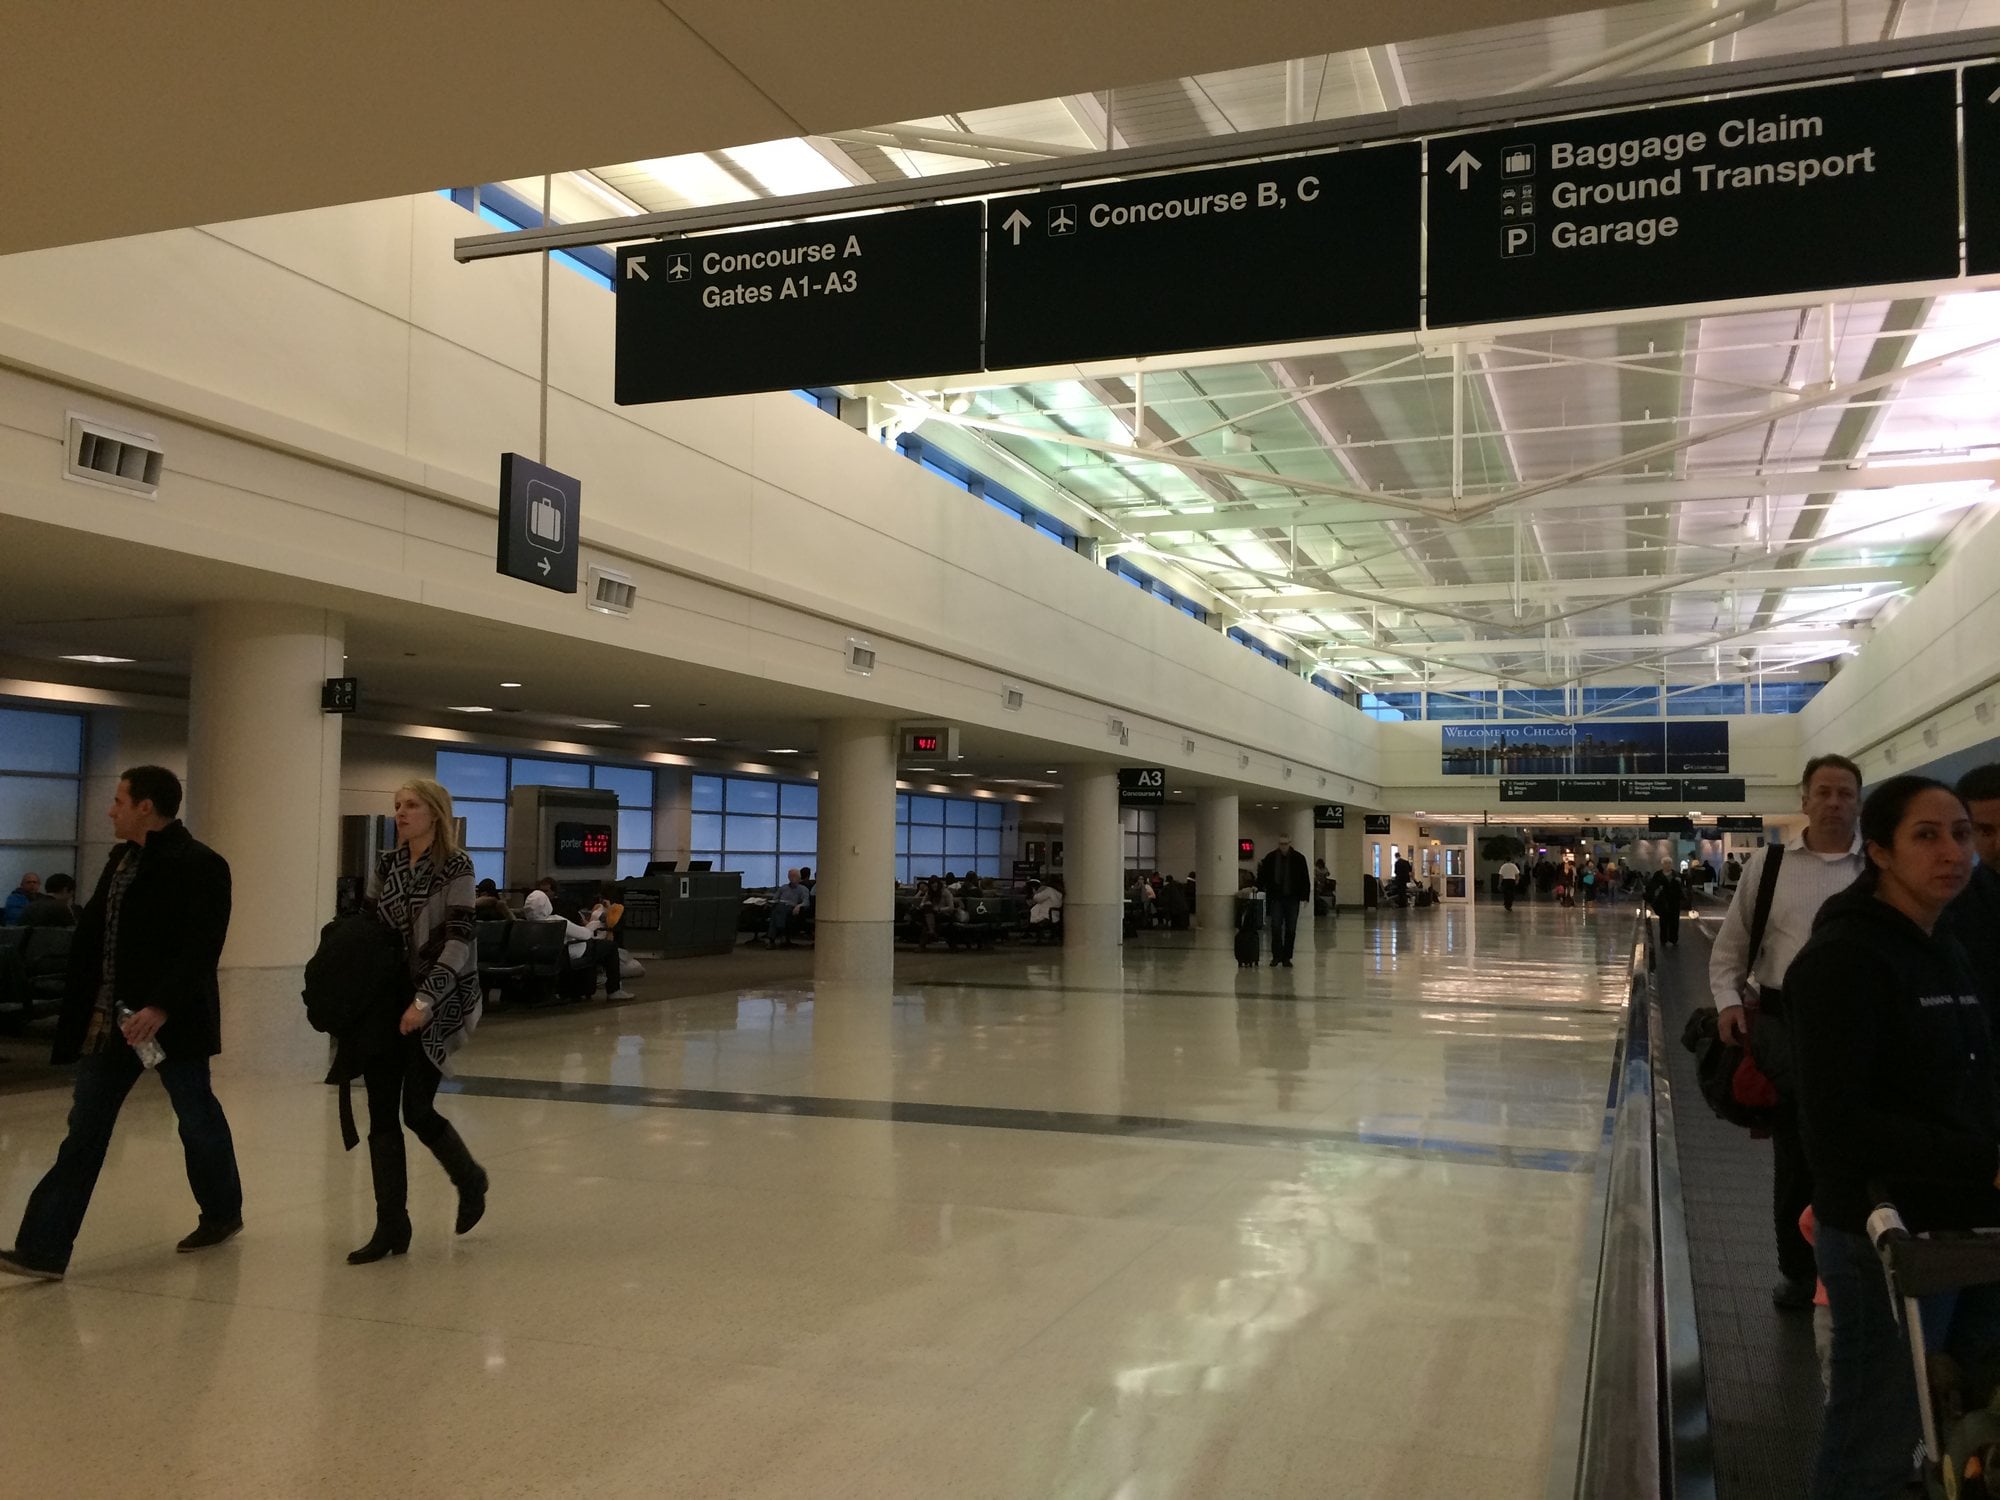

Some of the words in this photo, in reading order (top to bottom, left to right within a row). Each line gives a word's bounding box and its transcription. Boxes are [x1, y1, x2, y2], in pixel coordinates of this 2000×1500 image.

[1550, 130, 1707, 169] Baggage
[1718, 114, 1823, 148] Claim
[1551, 169, 1681, 209] Ground
[1692, 147, 1876, 192] Transport
[1089, 191, 1248, 228] Concourse
[1257, 181, 1287, 209] B,
[1297, 176, 1320, 202] C
[1551, 216, 1680, 249] Garage
[702, 243, 836, 275] Concourse
[842, 235, 862, 258] A
[702, 283, 773, 308] Gates
[779, 270, 858, 299] A1-A3
[1138, 770, 1162, 786] A3
[1326, 807, 1343, 817] A2
[1377, 816, 1389, 824] A1
[560, 838, 583, 850] porter
